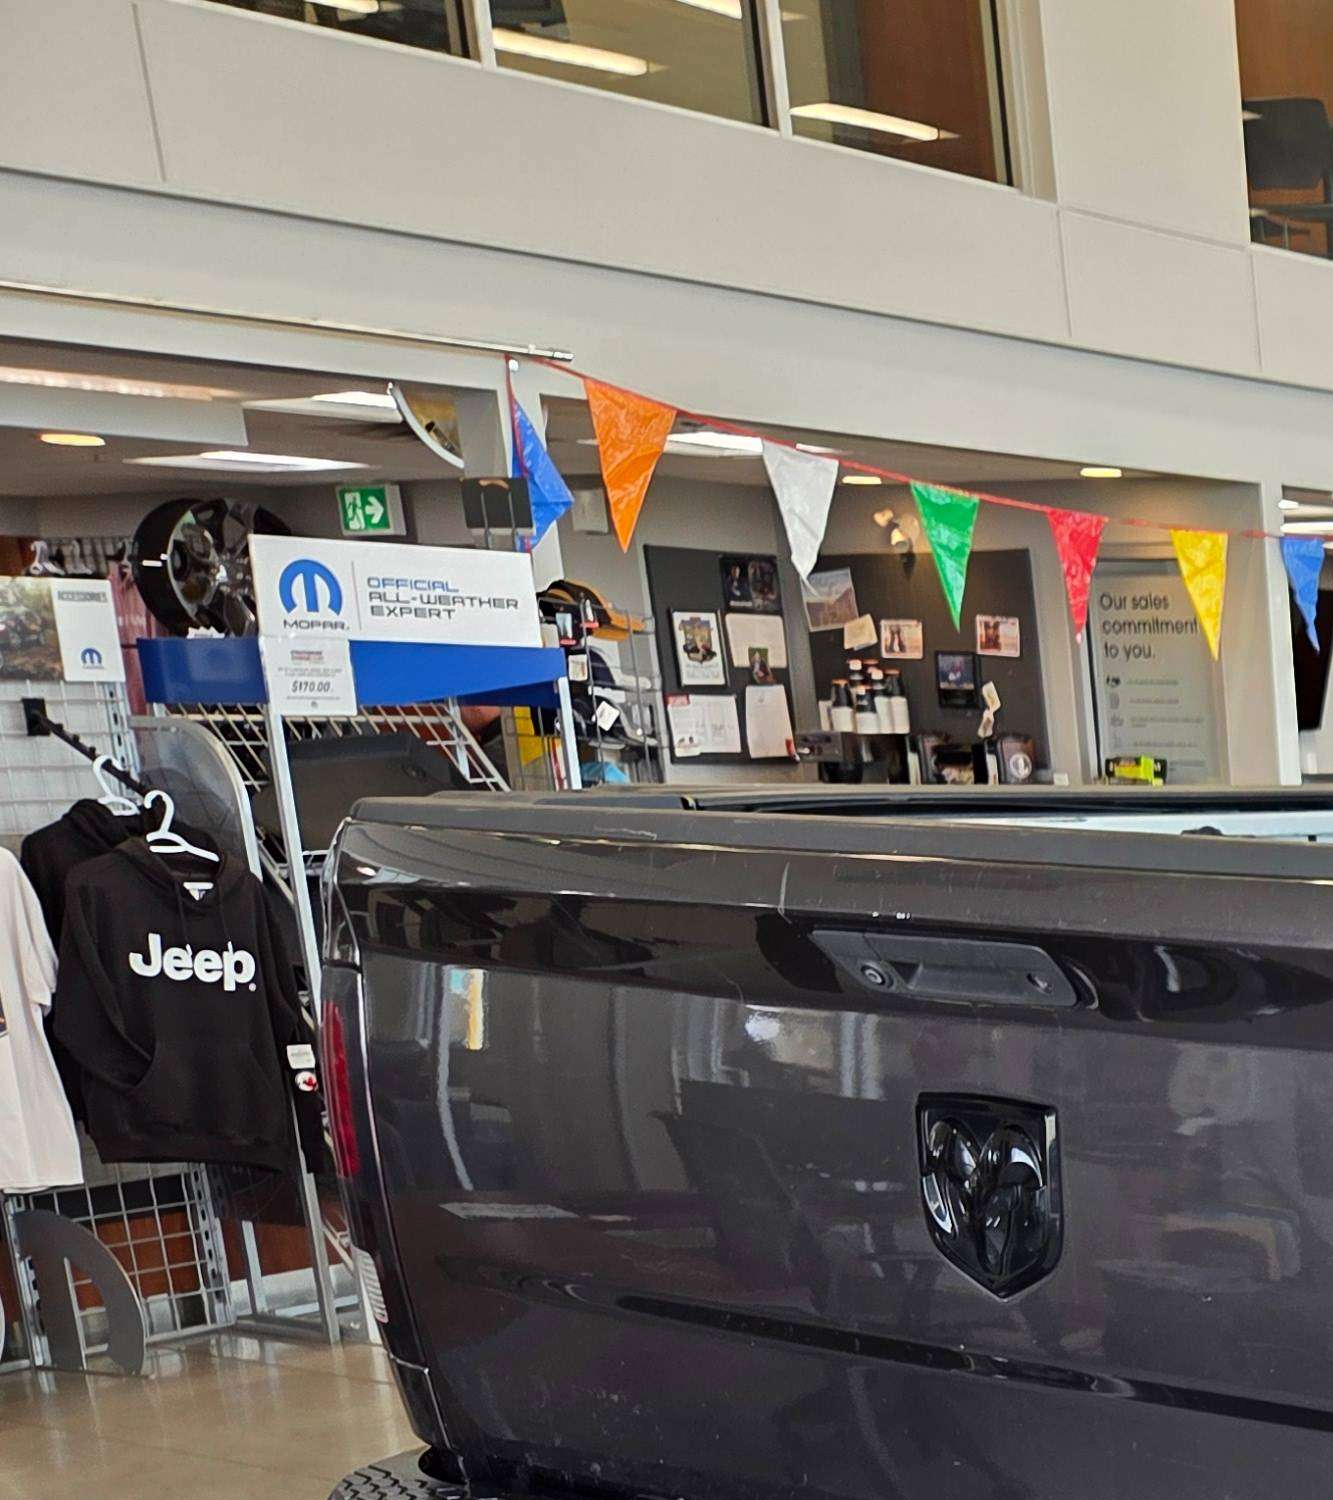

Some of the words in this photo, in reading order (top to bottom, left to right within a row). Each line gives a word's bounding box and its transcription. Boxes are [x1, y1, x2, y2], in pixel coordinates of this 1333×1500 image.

[367, 576, 459, 593] OFFICIAL
[368, 591, 519, 610] ALL-WEATHER
[1100, 593, 1127, 611] Our
[1131, 592, 1170, 610] sales
[370, 606, 456, 620] EXPERT
[1102, 617, 1199, 635] commitment
[1104, 642, 1119, 659] to
[1123, 643, 1156, 662] you.
[128, 932, 257, 992] Jeep
